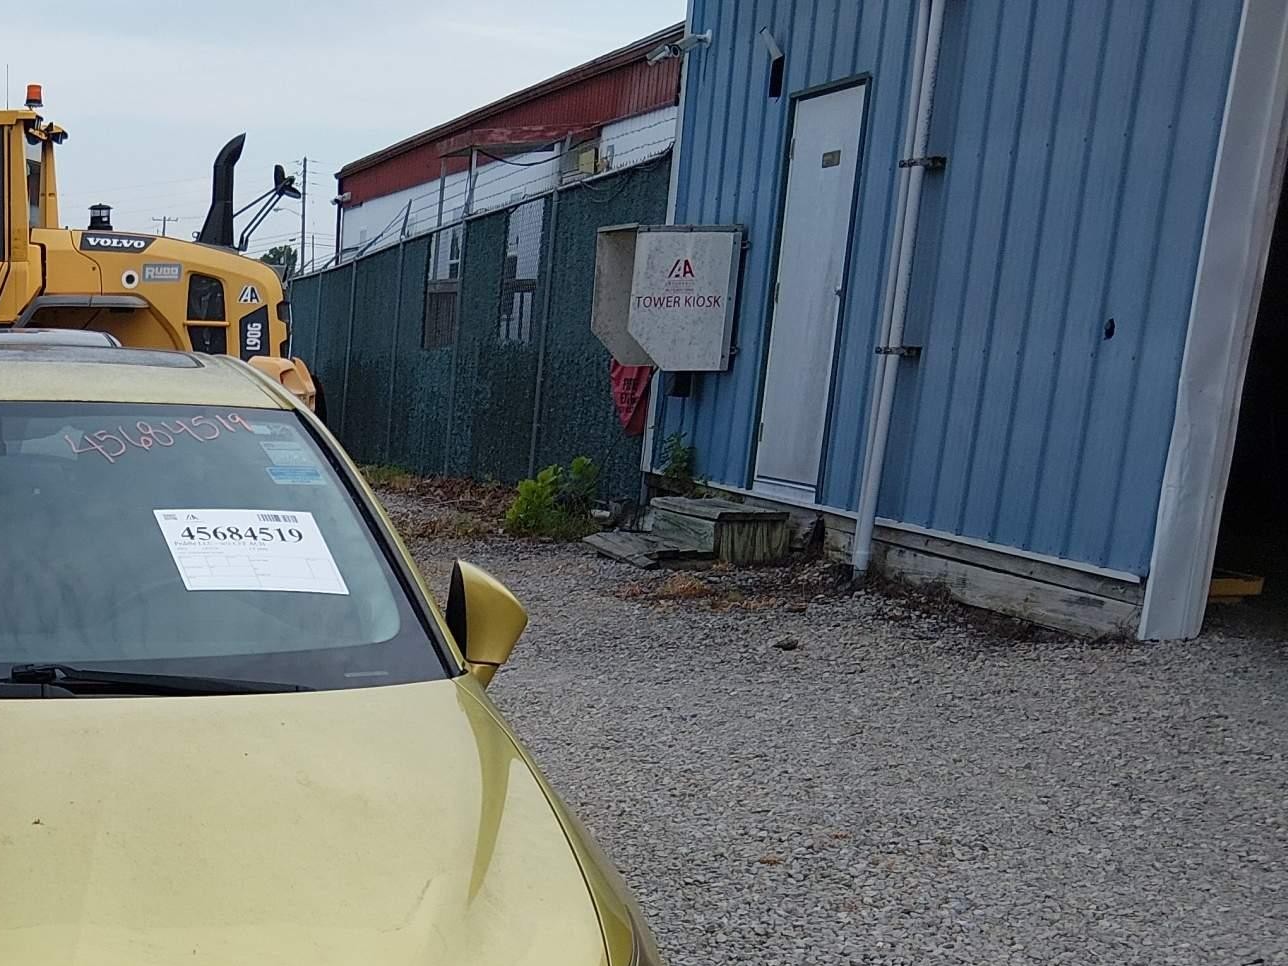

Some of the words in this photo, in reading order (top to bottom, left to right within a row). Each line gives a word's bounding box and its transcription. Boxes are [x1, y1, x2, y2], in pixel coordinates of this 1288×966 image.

[86, 236, 146, 249] VOLVO
[636, 295, 681, 309] TOWER
[684, 295, 721, 309] KIOSK
[246, 322, 261, 351] L90G
[64, 412, 254, 464] 45684519
[180, 526, 304, 544] 45684519
